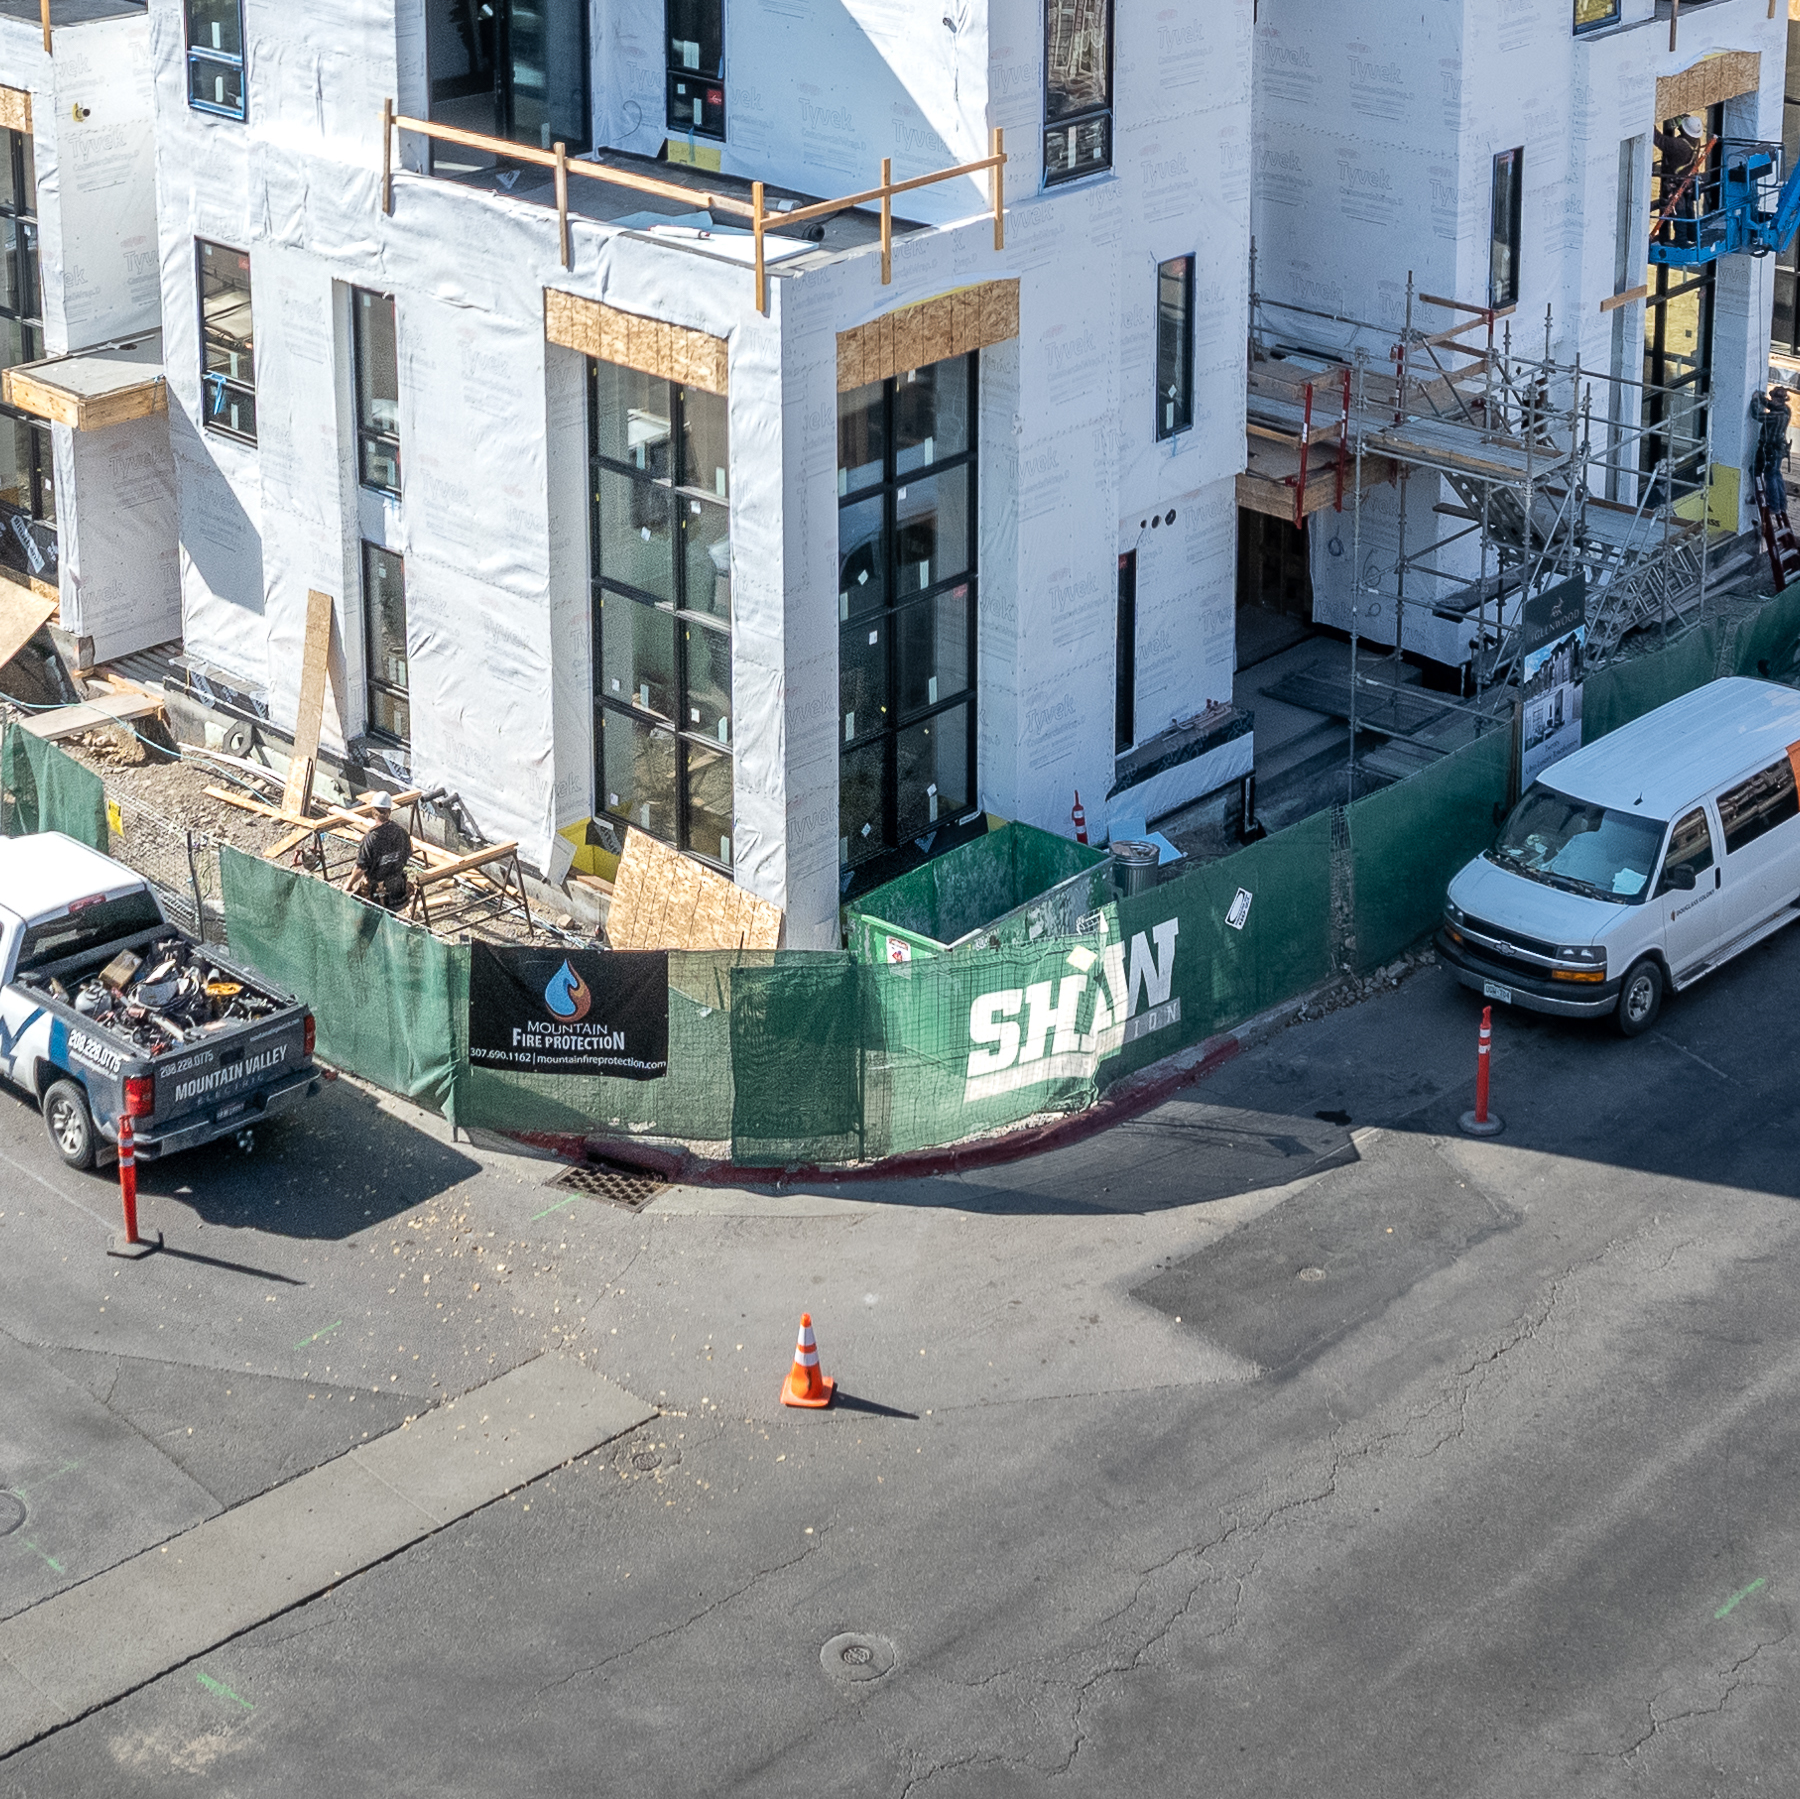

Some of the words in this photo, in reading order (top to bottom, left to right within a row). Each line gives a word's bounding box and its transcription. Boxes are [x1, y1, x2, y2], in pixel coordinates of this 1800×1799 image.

[1157, 19, 1204, 49] Tyvek
[798, 98, 855, 132] Tyvek
[69, 131, 127, 160] Tyvek
[1044, 330, 1096, 368] Tyvek
[1049, 574, 1099, 612] Tyvek
[967, 917, 1179, 1078] SHAW
[512, 1027, 542, 1048] FIRE
[545, 1031, 625, 1050] PROTECTION
[527, 1021, 608, 1035] MOUNTAIN
[160, 1049, 215, 1079] 208.228.0775
[174, 1061, 243, 1102] MOUNTAIN
[245, 1044, 288, 1075] VALLEY
[470, 1047, 531, 1062] 307.690.1162
[537, 1054, 666, 1070] mountainfireprotection.com
